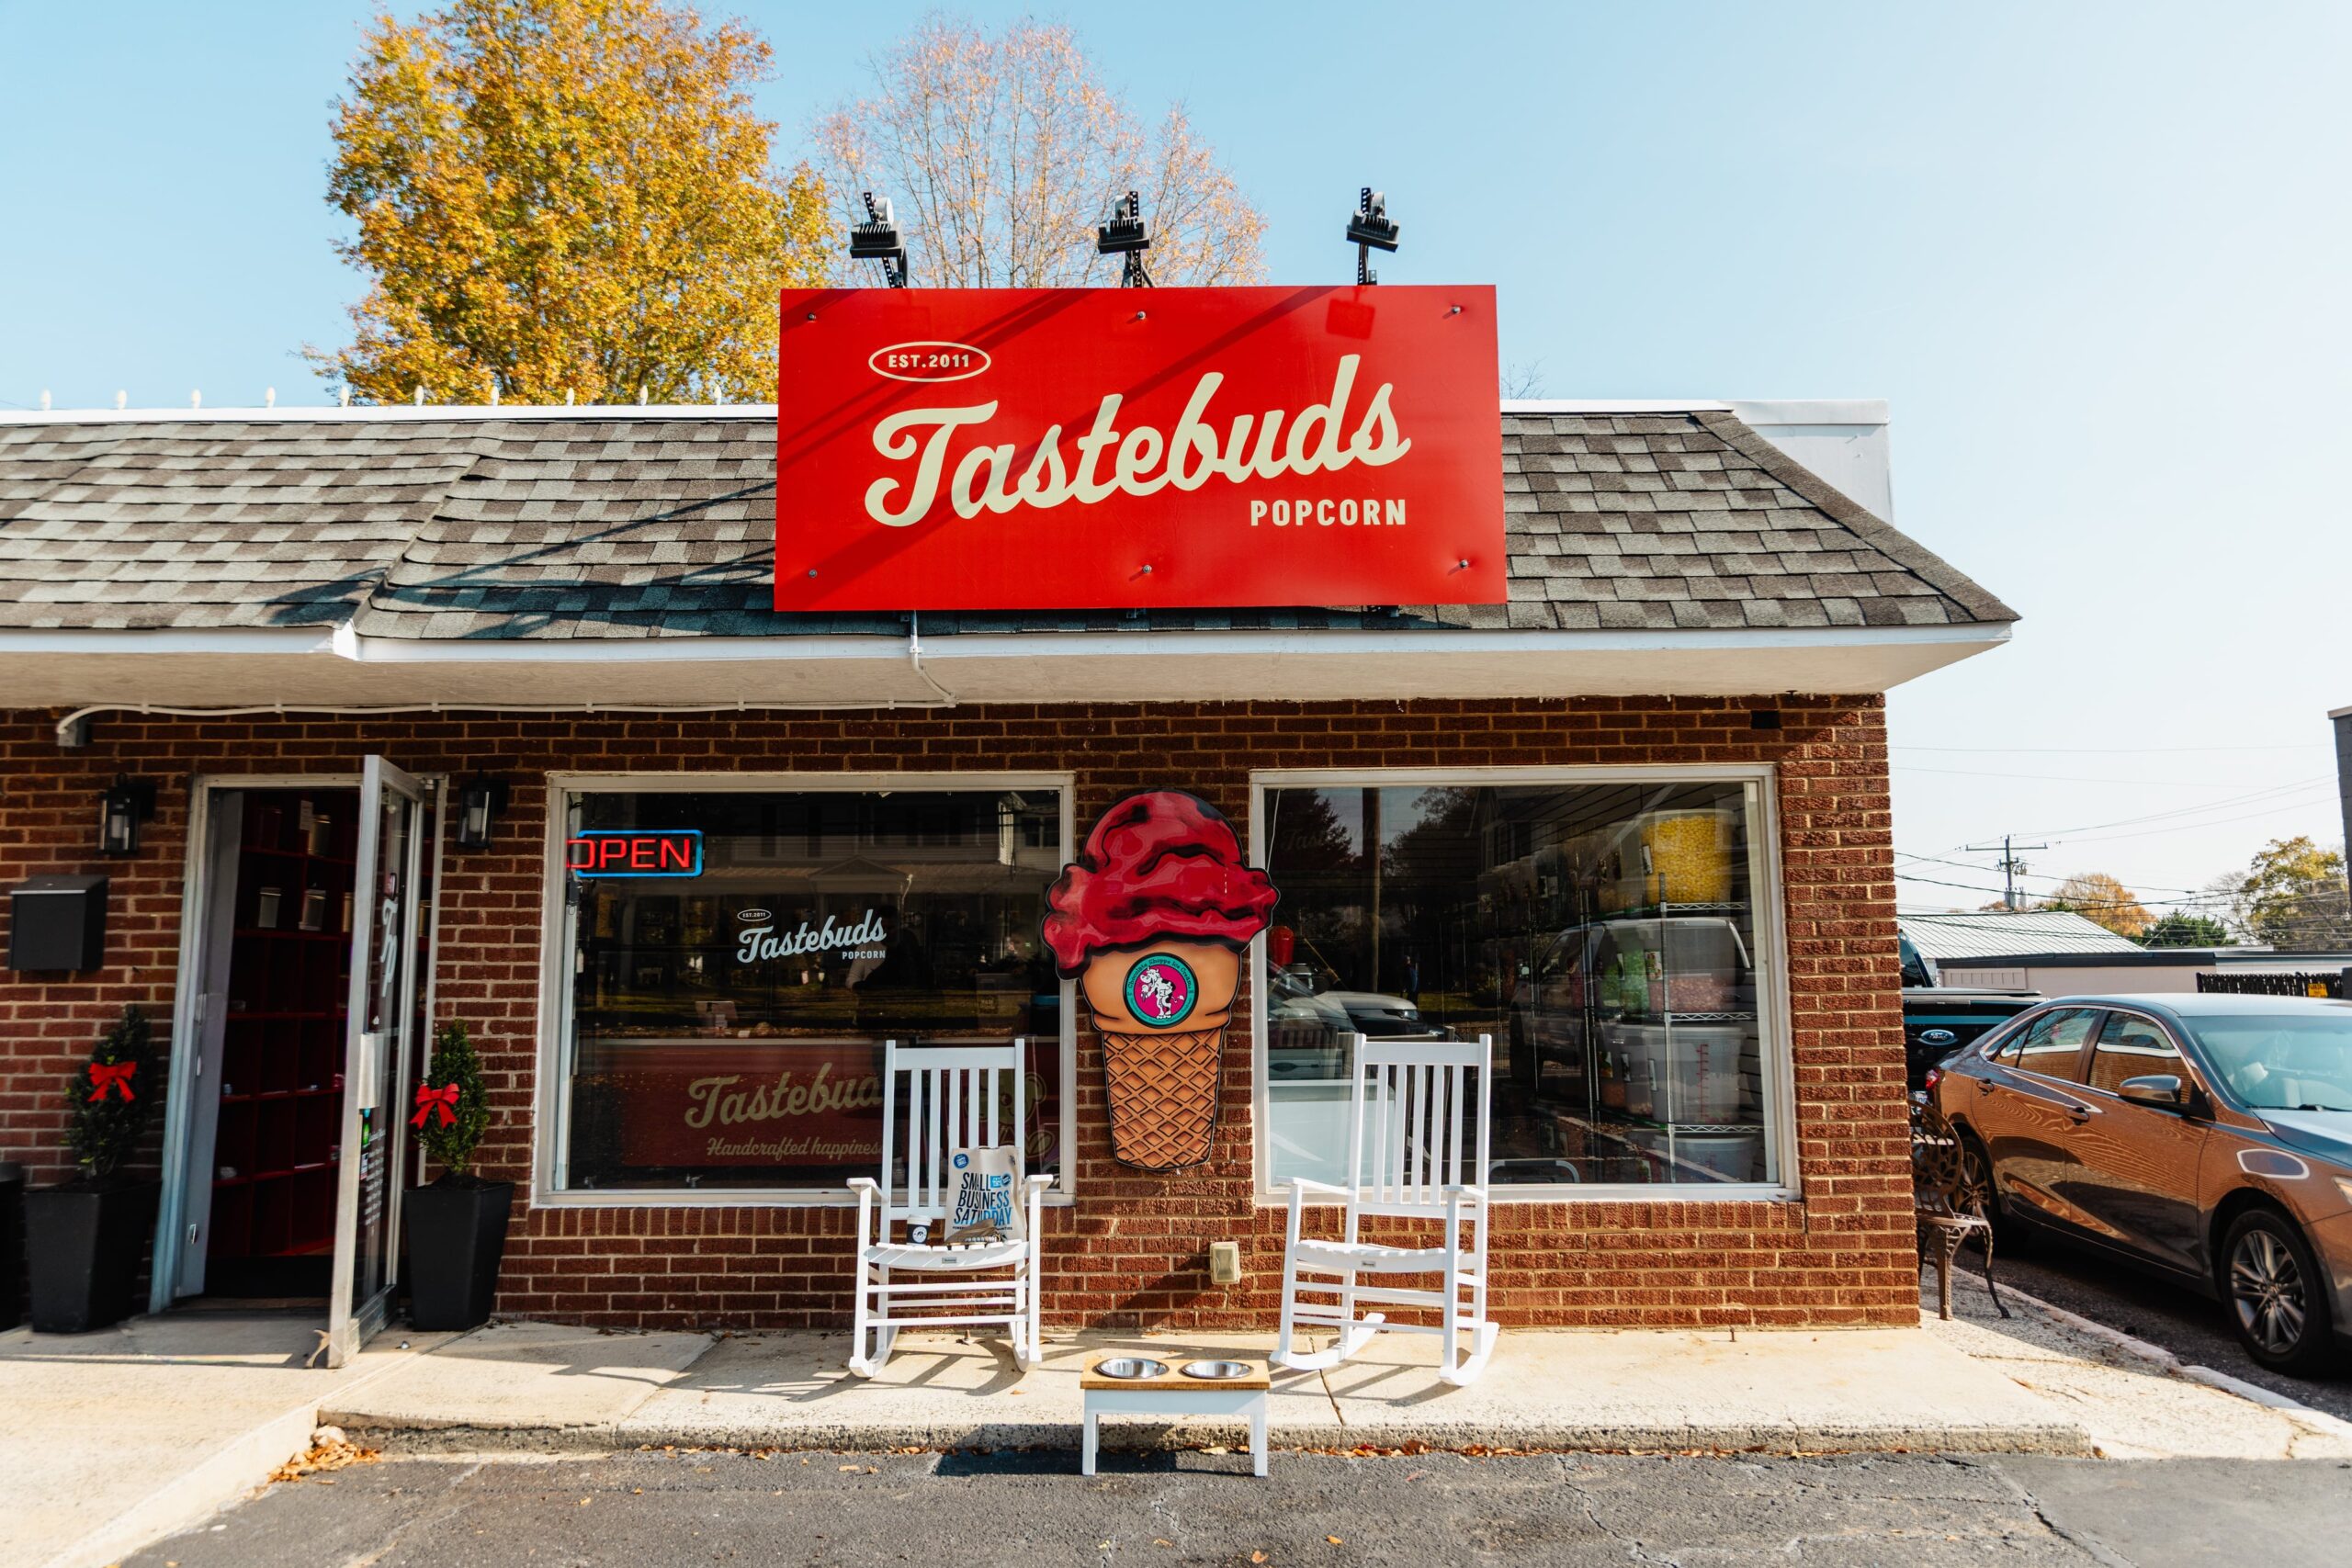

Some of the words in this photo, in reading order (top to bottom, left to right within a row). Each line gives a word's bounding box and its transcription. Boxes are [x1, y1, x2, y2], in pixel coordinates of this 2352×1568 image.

[888, 354, 969, 368] EST.2011
[865, 354, 1411, 528] Tastebuds
[1250, 499, 1408, 527] POPCORN
[566, 838, 690, 869] OPEN
[737, 908, 888, 964] Tastebuds
[842, 950, 887, 960] POPCORN
[684, 1061, 885, 1130] Tastebud
[707, 1136, 810, 1162] Handcrafted
[810, 1136, 884, 1162] happines
[961, 1171, 991, 1192] SMALL
[957, 1190, 1010, 1210] BUSINESS
